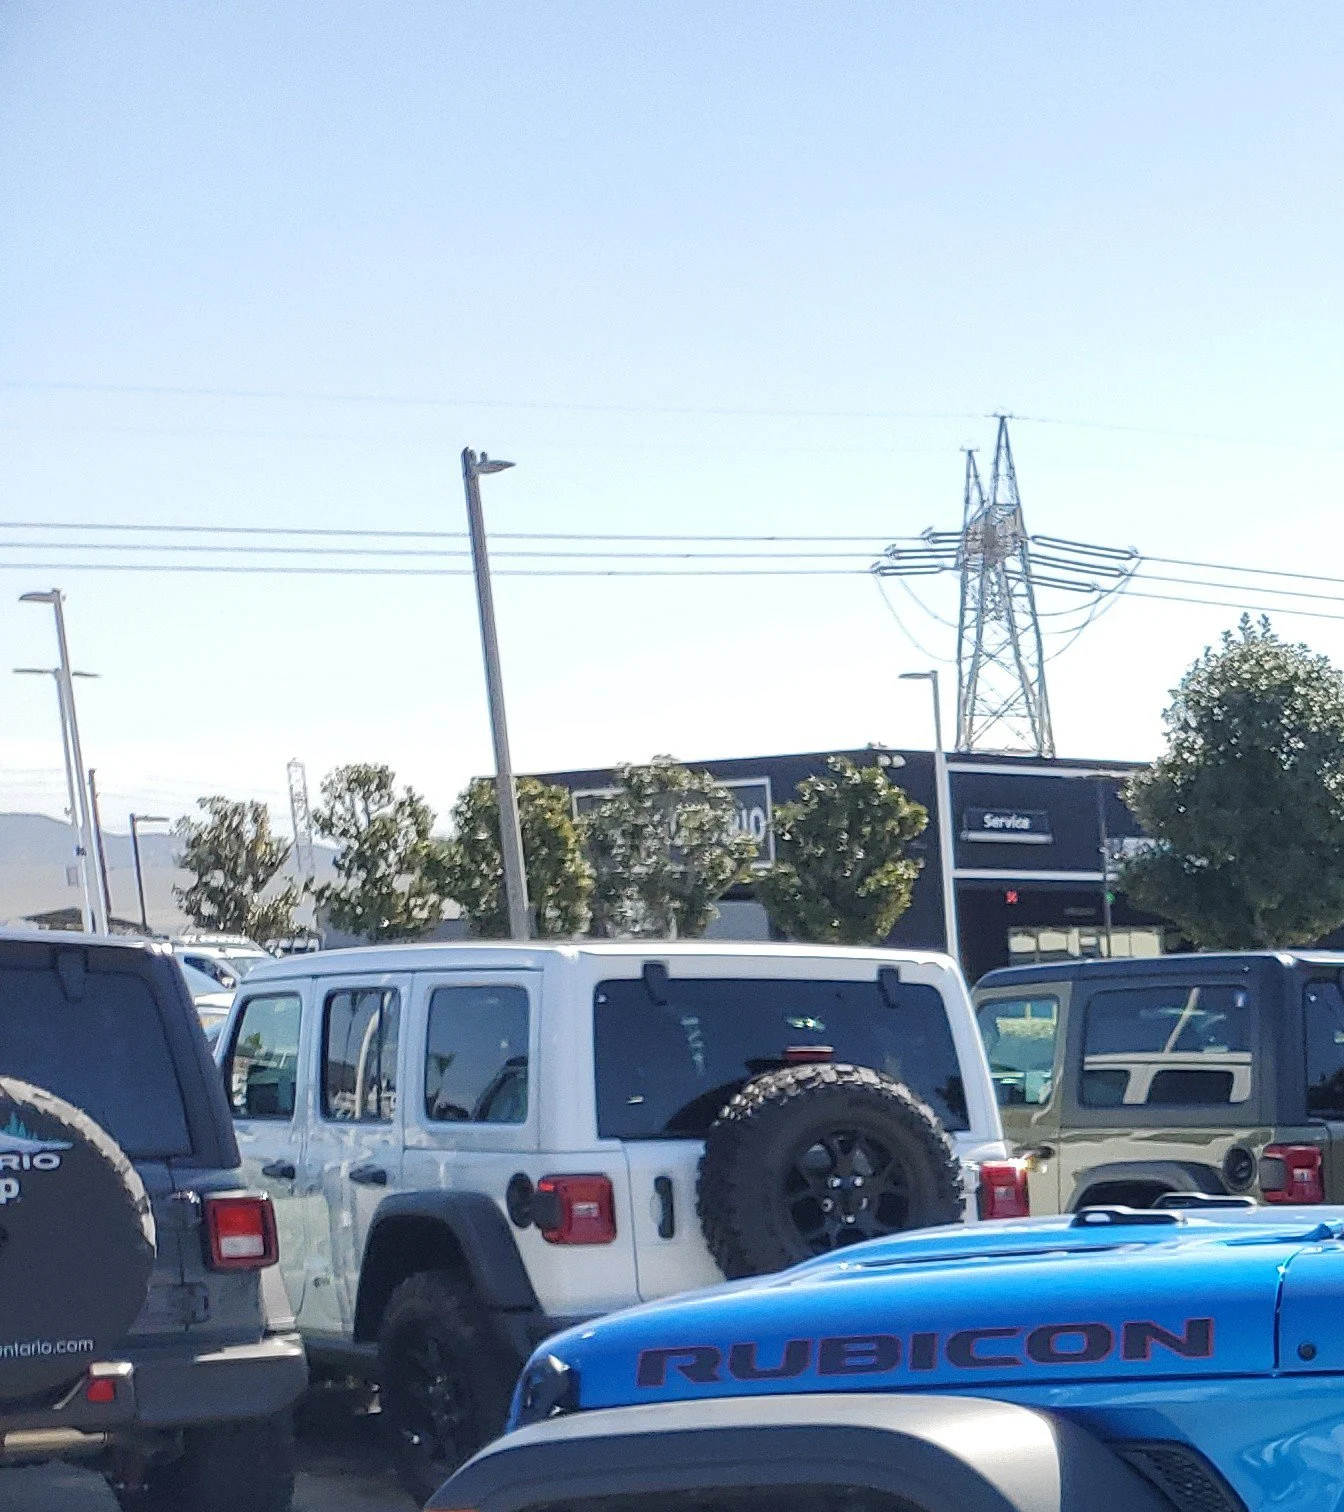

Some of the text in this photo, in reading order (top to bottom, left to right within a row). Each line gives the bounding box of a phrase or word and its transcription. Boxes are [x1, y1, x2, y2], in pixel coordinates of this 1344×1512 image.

[983, 813, 1032, 830] Service
[0, 1152, 61, 1171] RIO
[636, 1317, 1216, 1388] RUBICON
